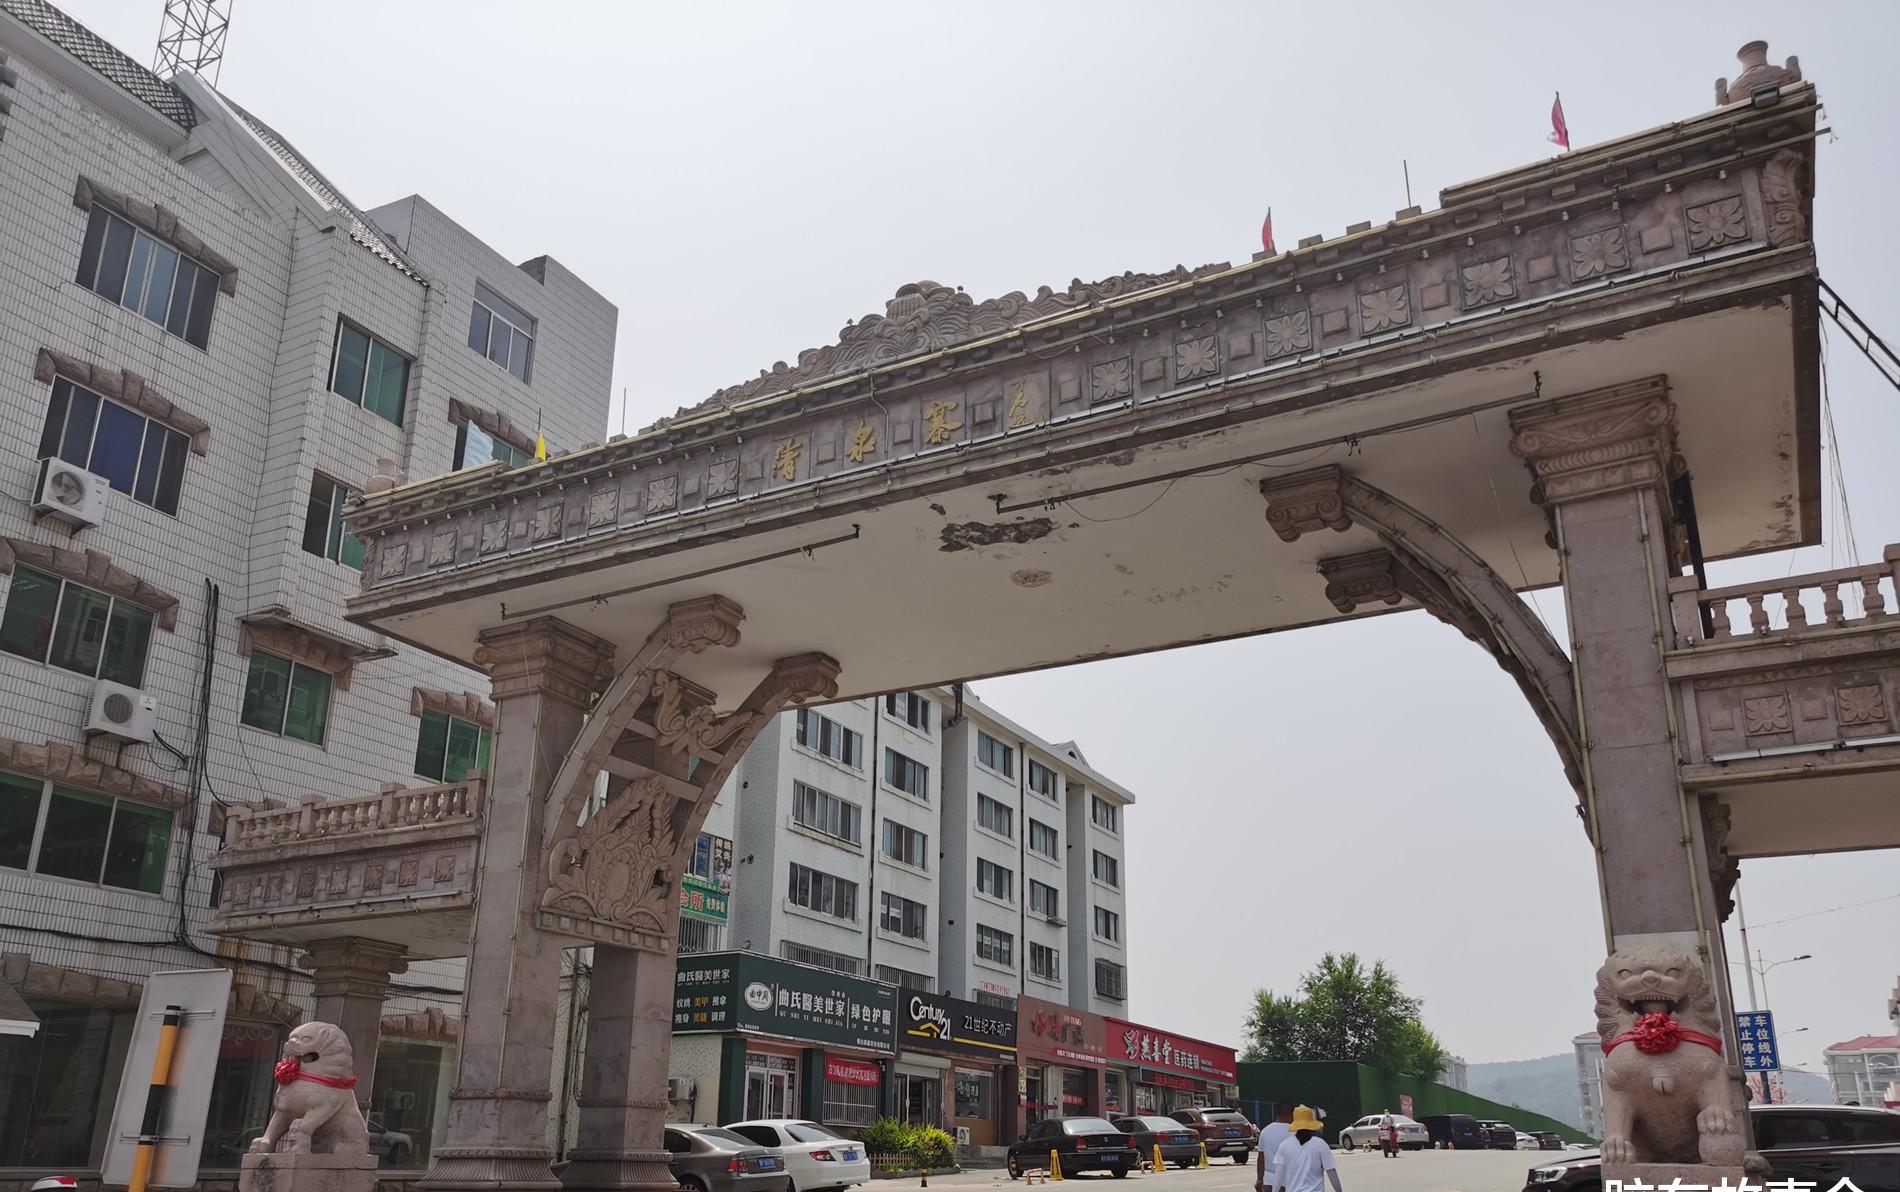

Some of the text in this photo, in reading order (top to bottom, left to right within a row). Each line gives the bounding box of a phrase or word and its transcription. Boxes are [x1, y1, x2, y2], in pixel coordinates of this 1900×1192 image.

[851, 1003, 891, 1026] 绿色护眼
[910, 996, 945, 1025] Century
[939, 1018, 951, 1040] 21
[964, 1015, 1012, 1037] 21世纪不动产
[1737, 1015, 1757, 1068] 禁止停车
[1754, 1015, 1774, 1068] 车位线外
[1174, 1049, 1201, 1070] 医药连锁
